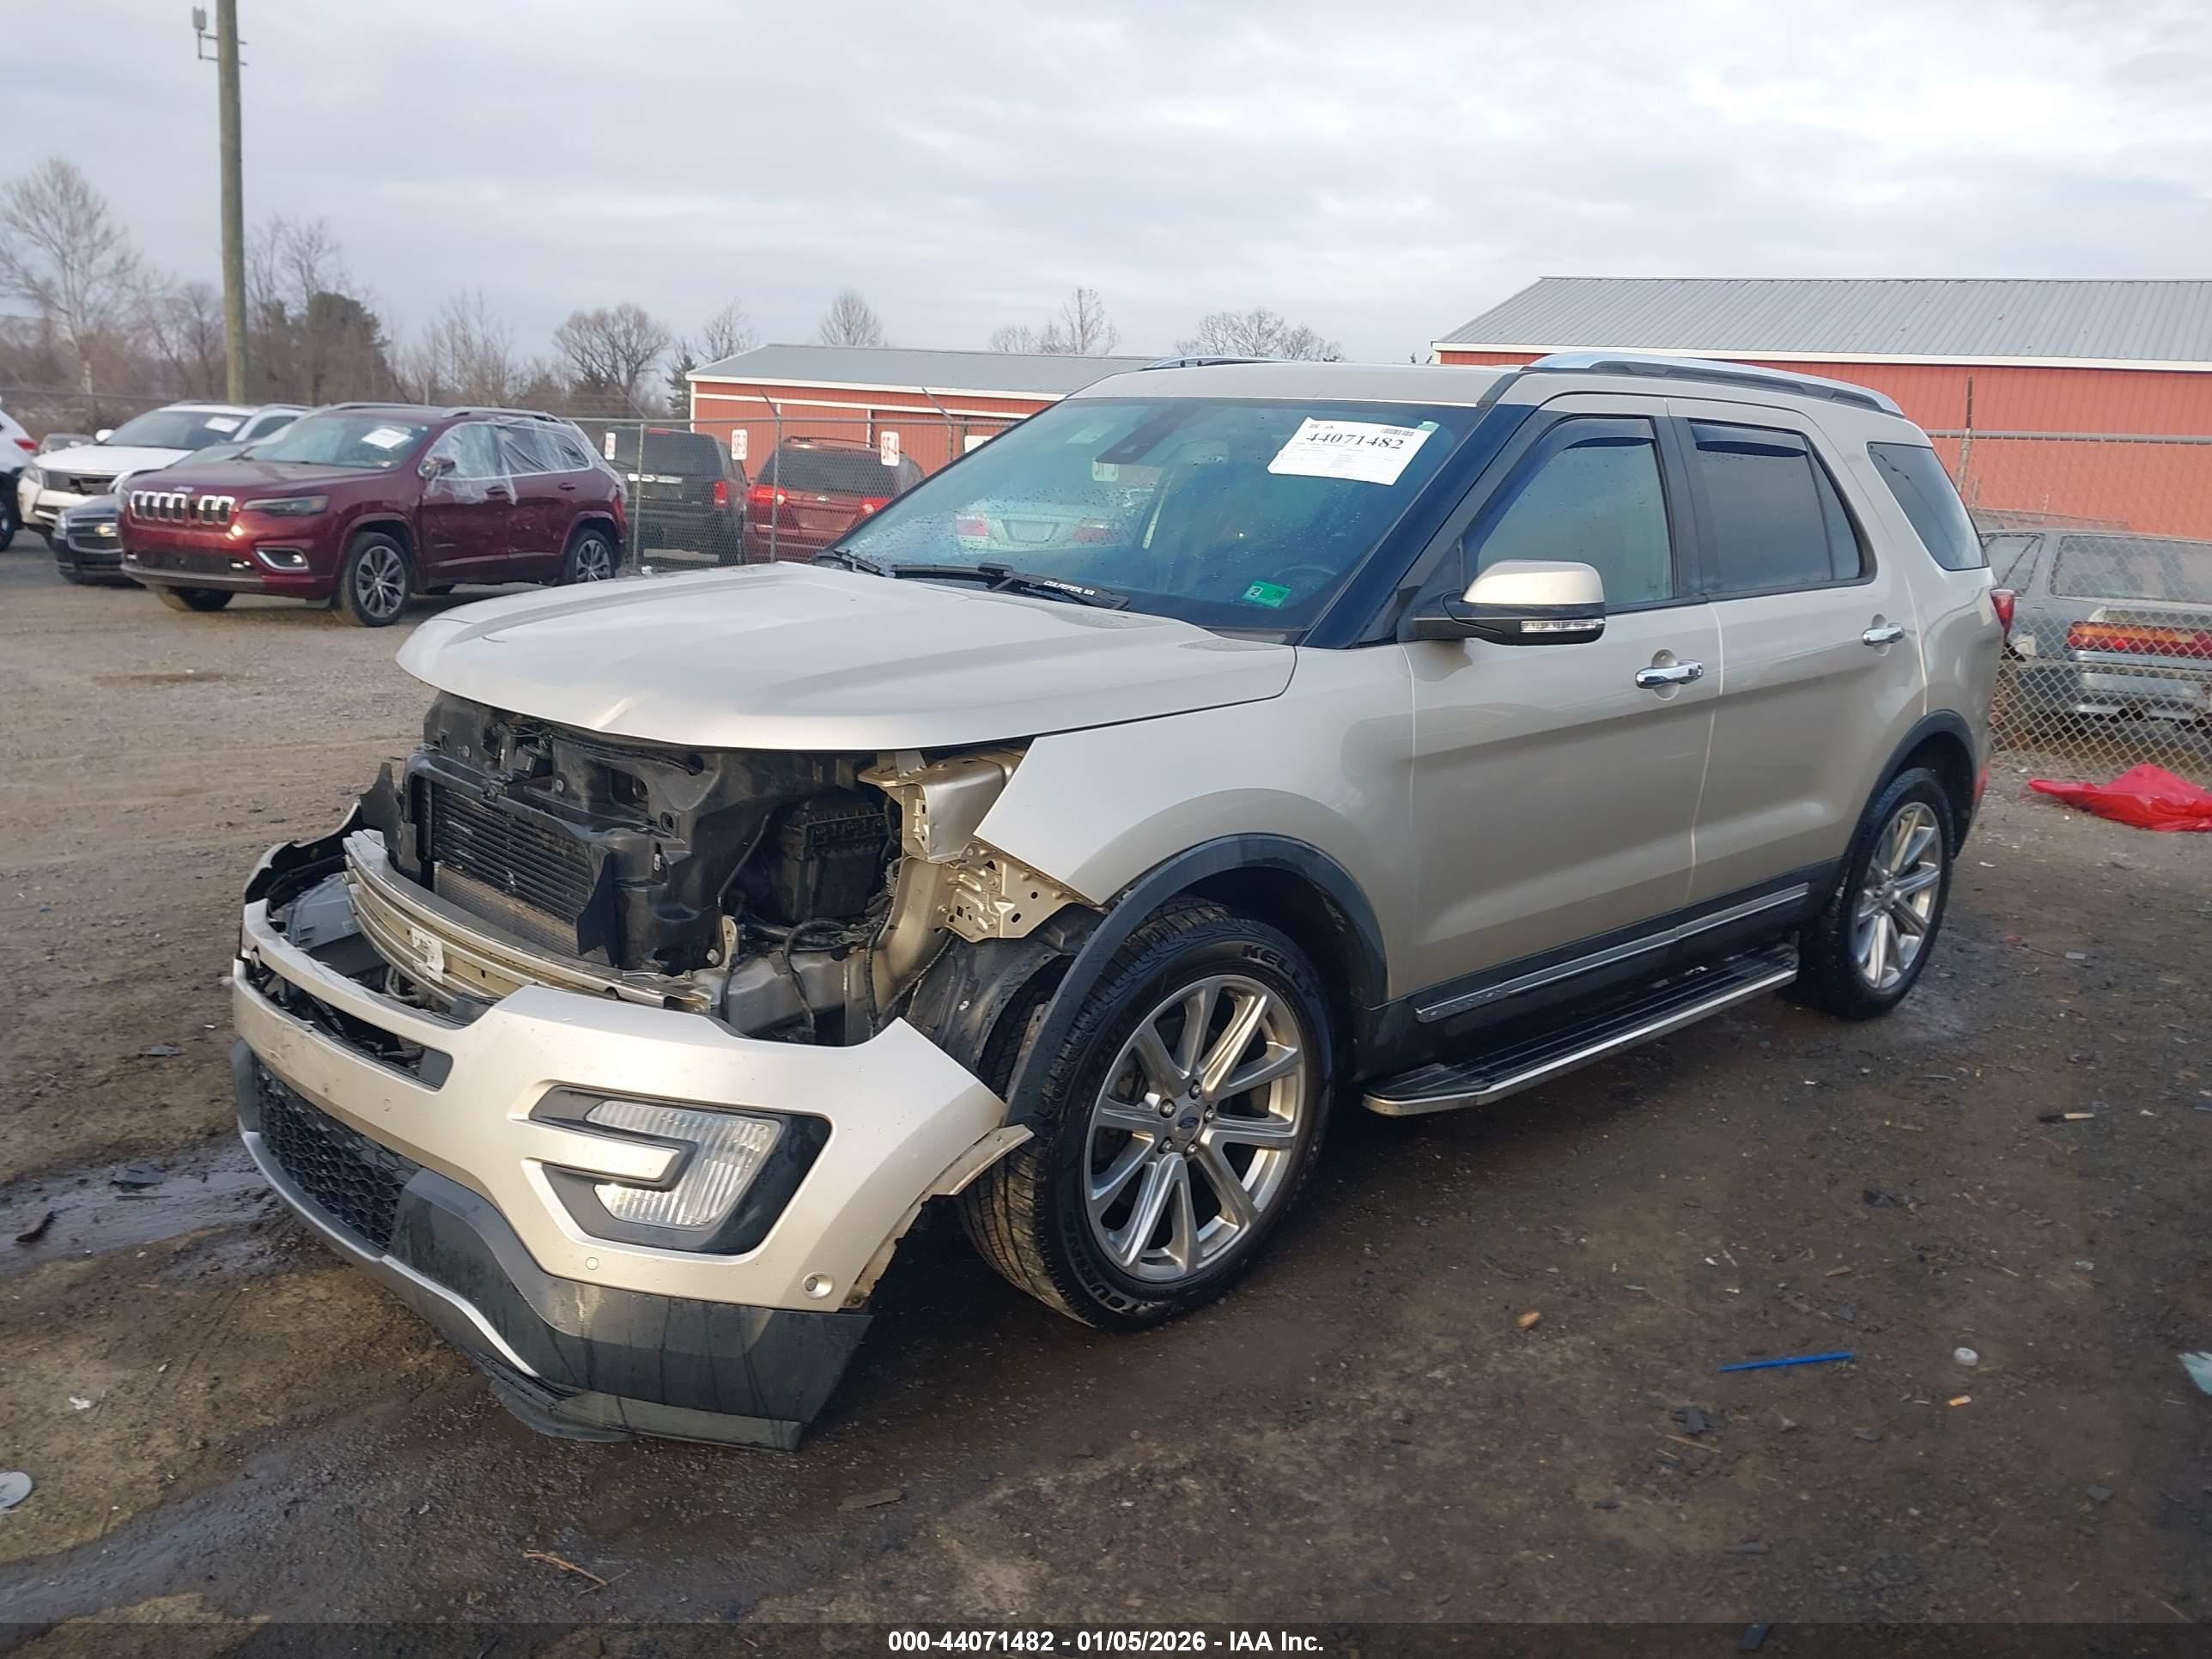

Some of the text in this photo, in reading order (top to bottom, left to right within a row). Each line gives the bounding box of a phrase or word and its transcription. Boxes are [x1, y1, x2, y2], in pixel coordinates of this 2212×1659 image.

[1305, 432, 1404, 449] 44071482
[1249, 587, 1261, 597] 2
[1240, 945, 1317, 999] KELLY
